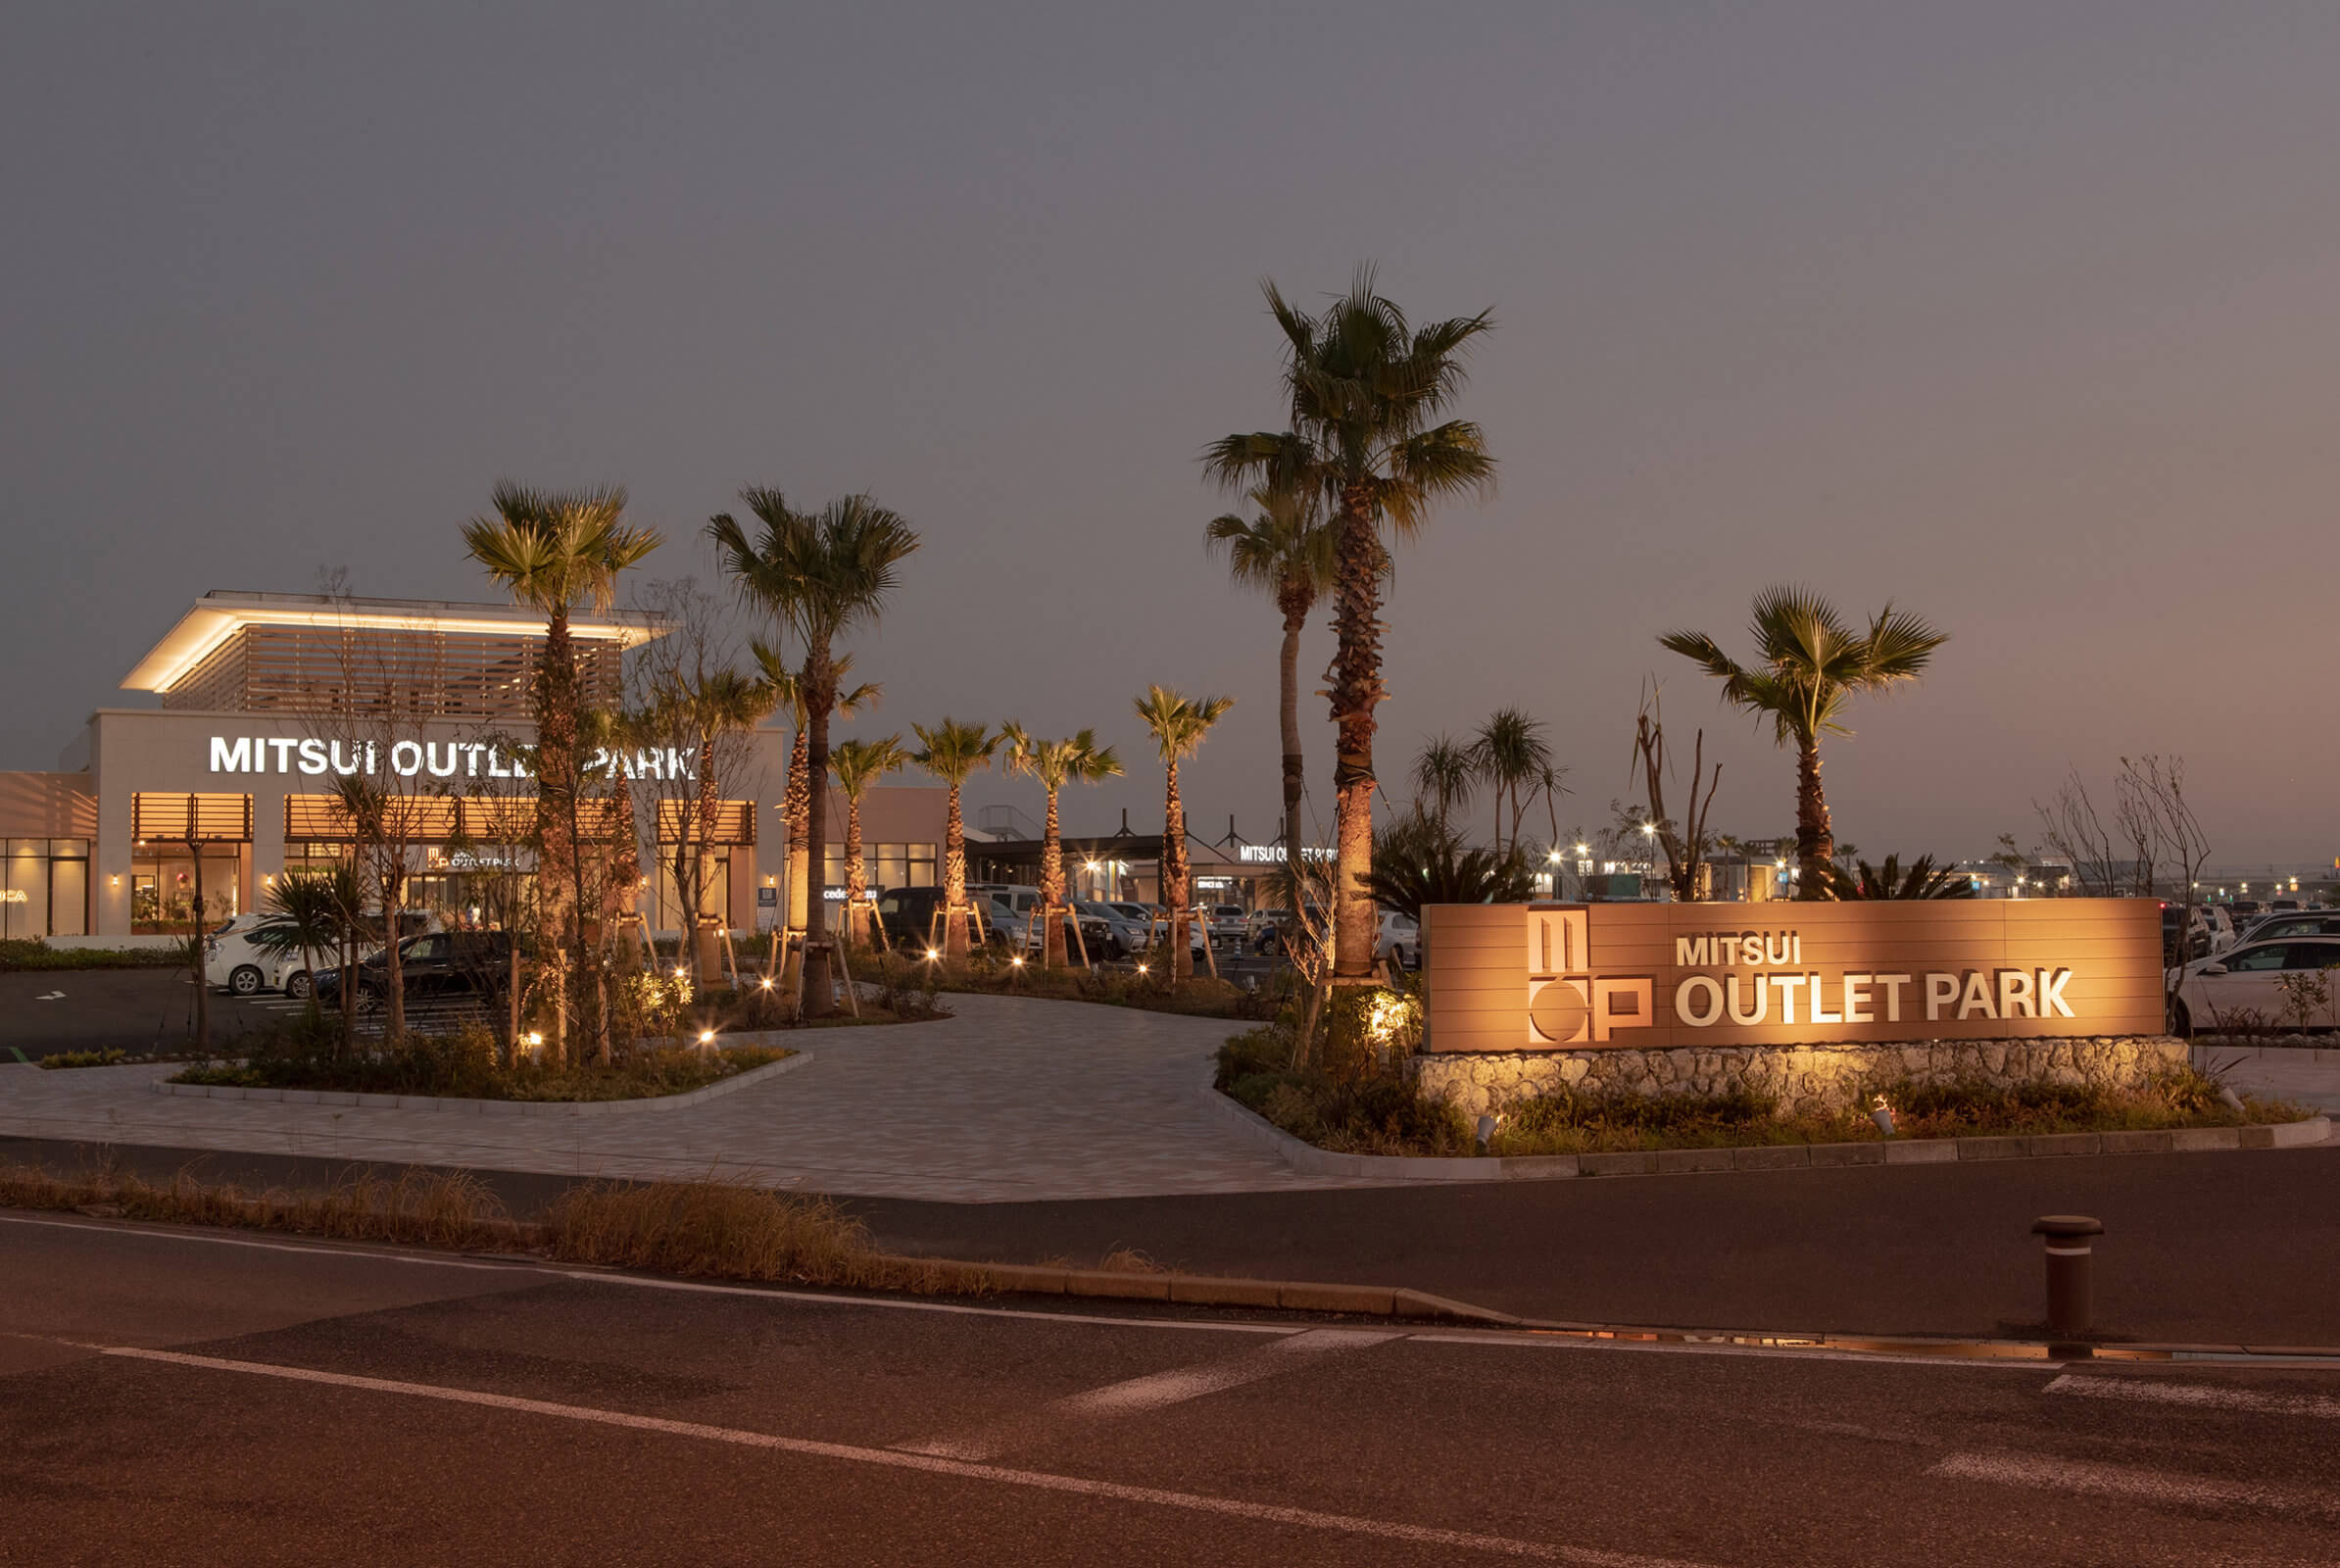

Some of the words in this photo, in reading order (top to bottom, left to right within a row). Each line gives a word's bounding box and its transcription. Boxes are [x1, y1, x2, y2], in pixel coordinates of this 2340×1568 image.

[210, 737, 375, 775] MITSUI
[1241, 846, 1276, 862] MITSUI
[1677, 936, 1800, 966] MITSUI
[1676, 975, 1911, 1026] OUTLET
[1926, 971, 2075, 1020] PARK
